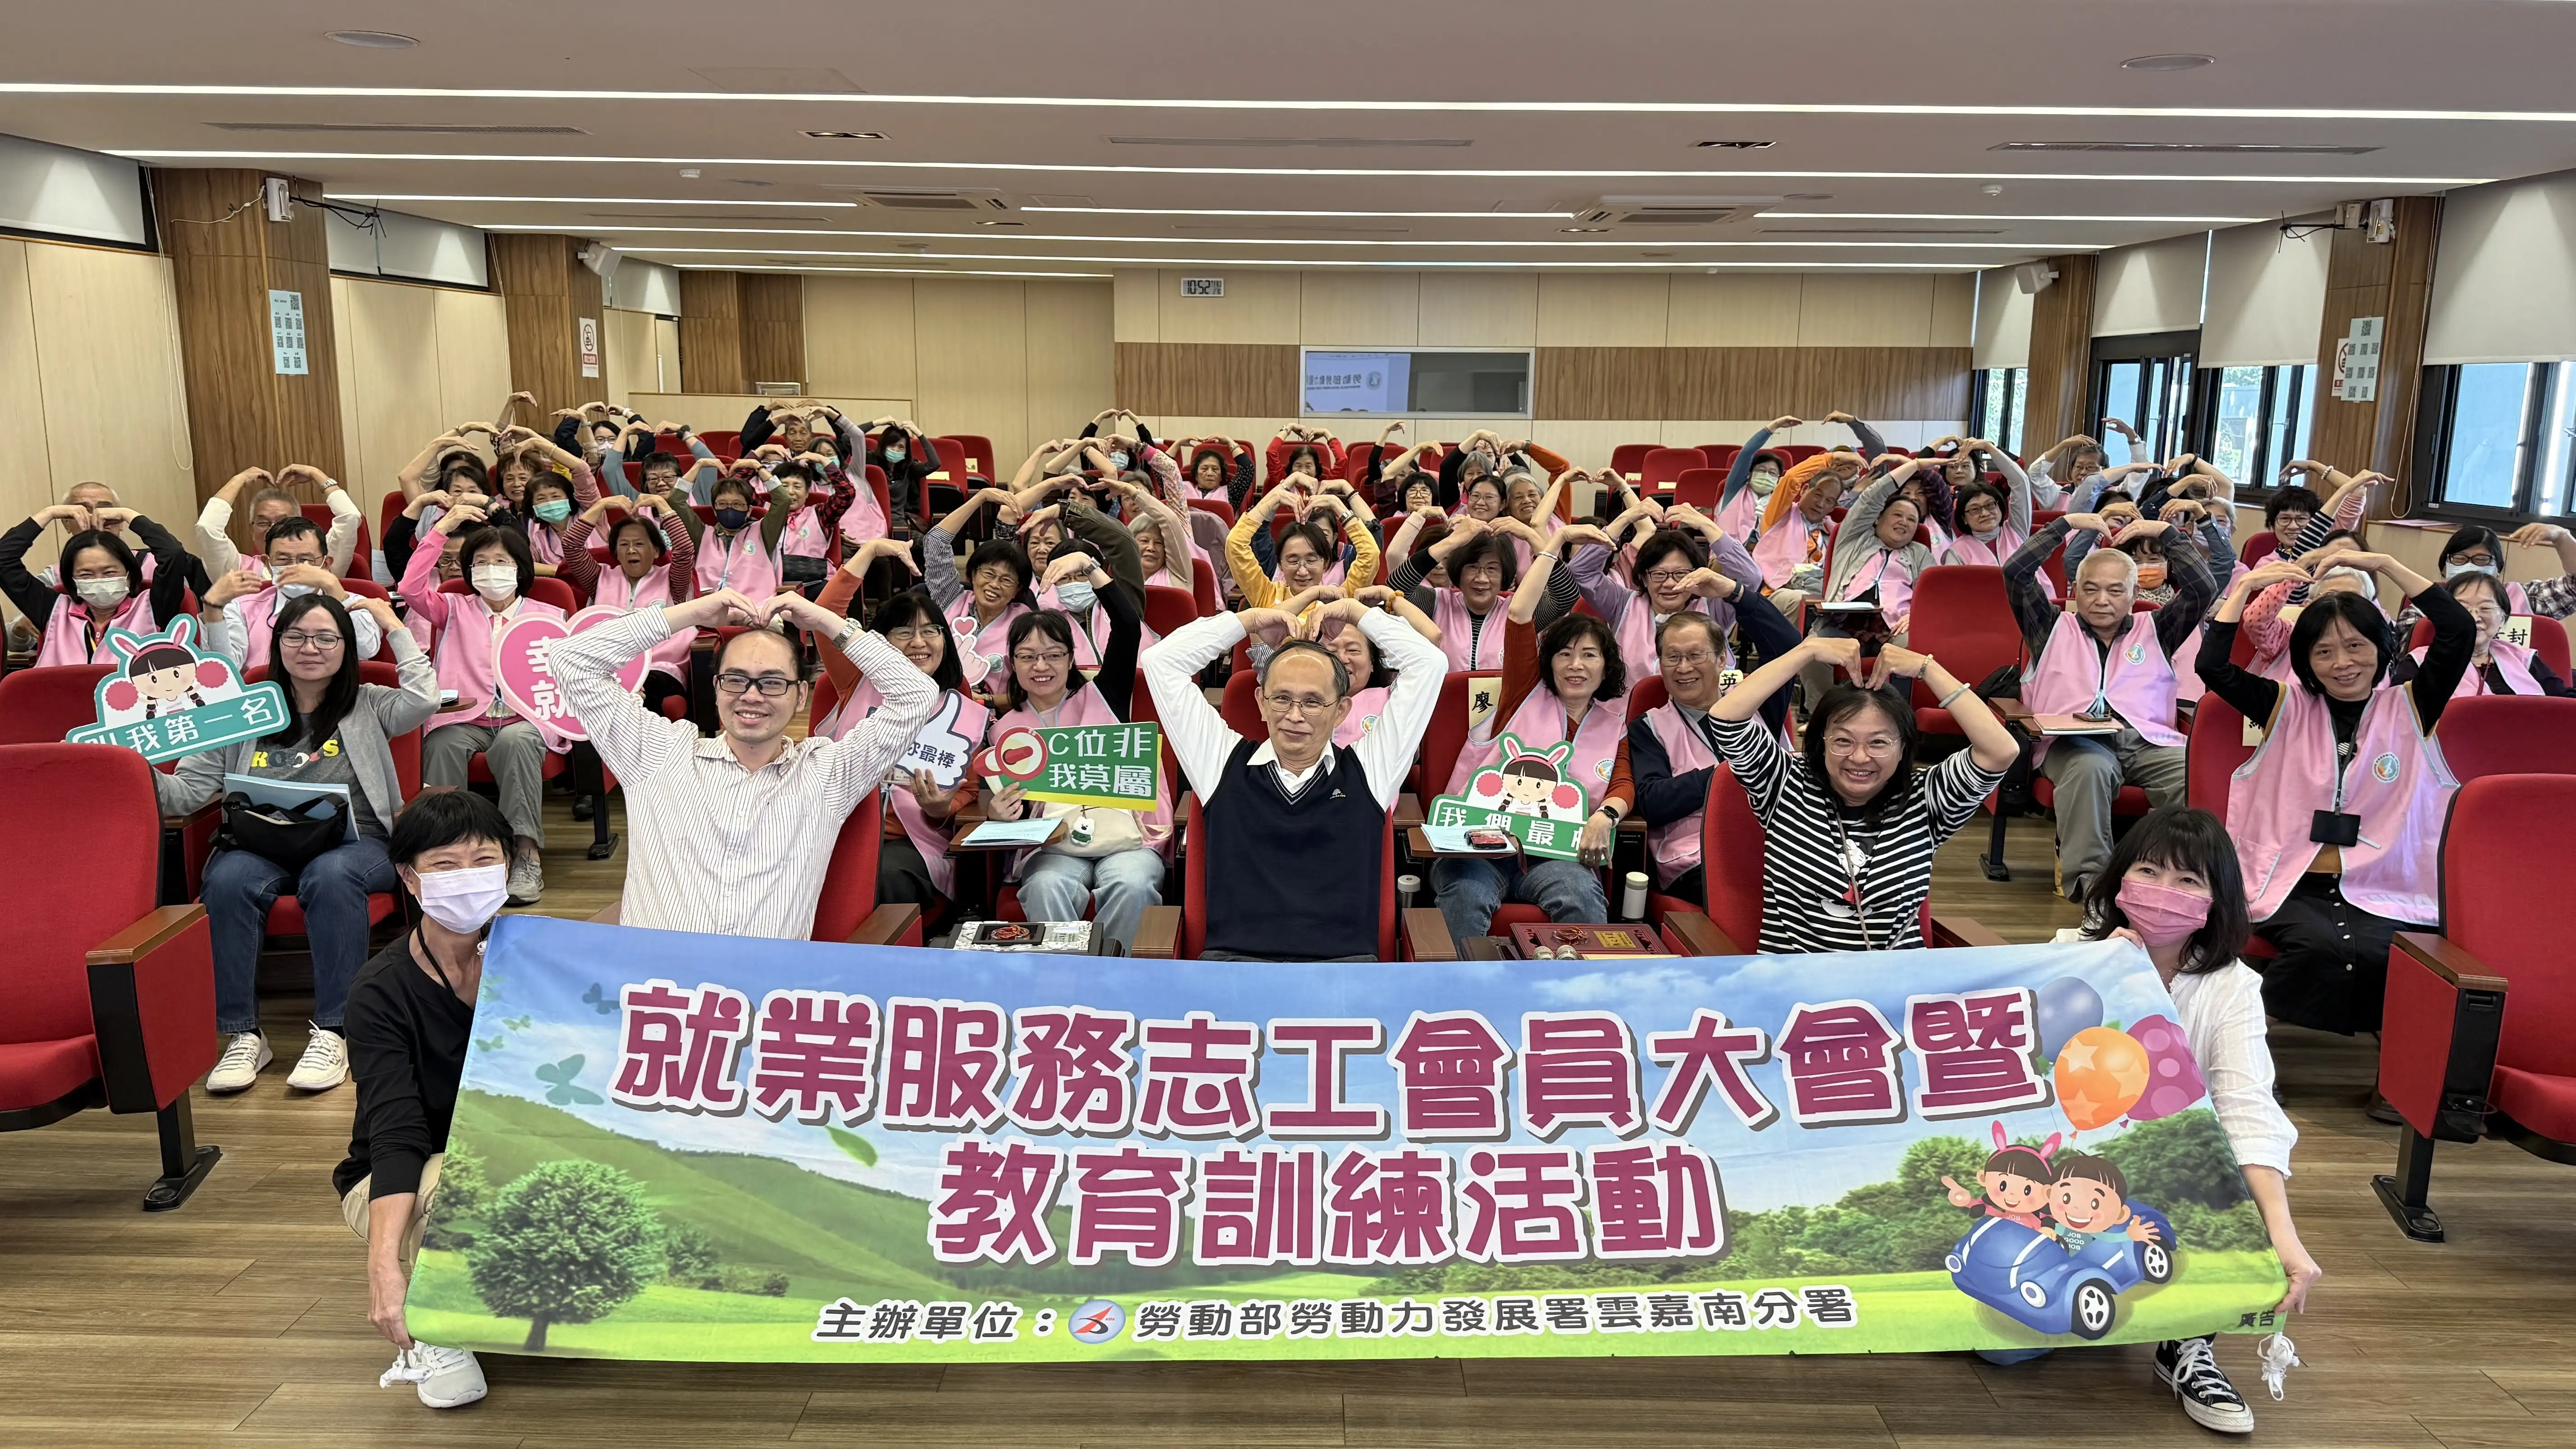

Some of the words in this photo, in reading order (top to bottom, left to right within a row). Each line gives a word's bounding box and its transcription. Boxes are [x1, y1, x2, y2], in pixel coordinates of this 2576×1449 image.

[1048, 727, 1152, 758] C位非
[1049, 763, 1152, 796] 我莫屬
[613, 983, 2043, 1132] 就業服務志工會員大會暨
[933, 1141, 1723, 1262] 教育訓練活動
[816, 1302, 1052, 1339] 主辦單位：
[1137, 1288, 1852, 1338] 勞動部勞動力發展署雲嘉南分署
